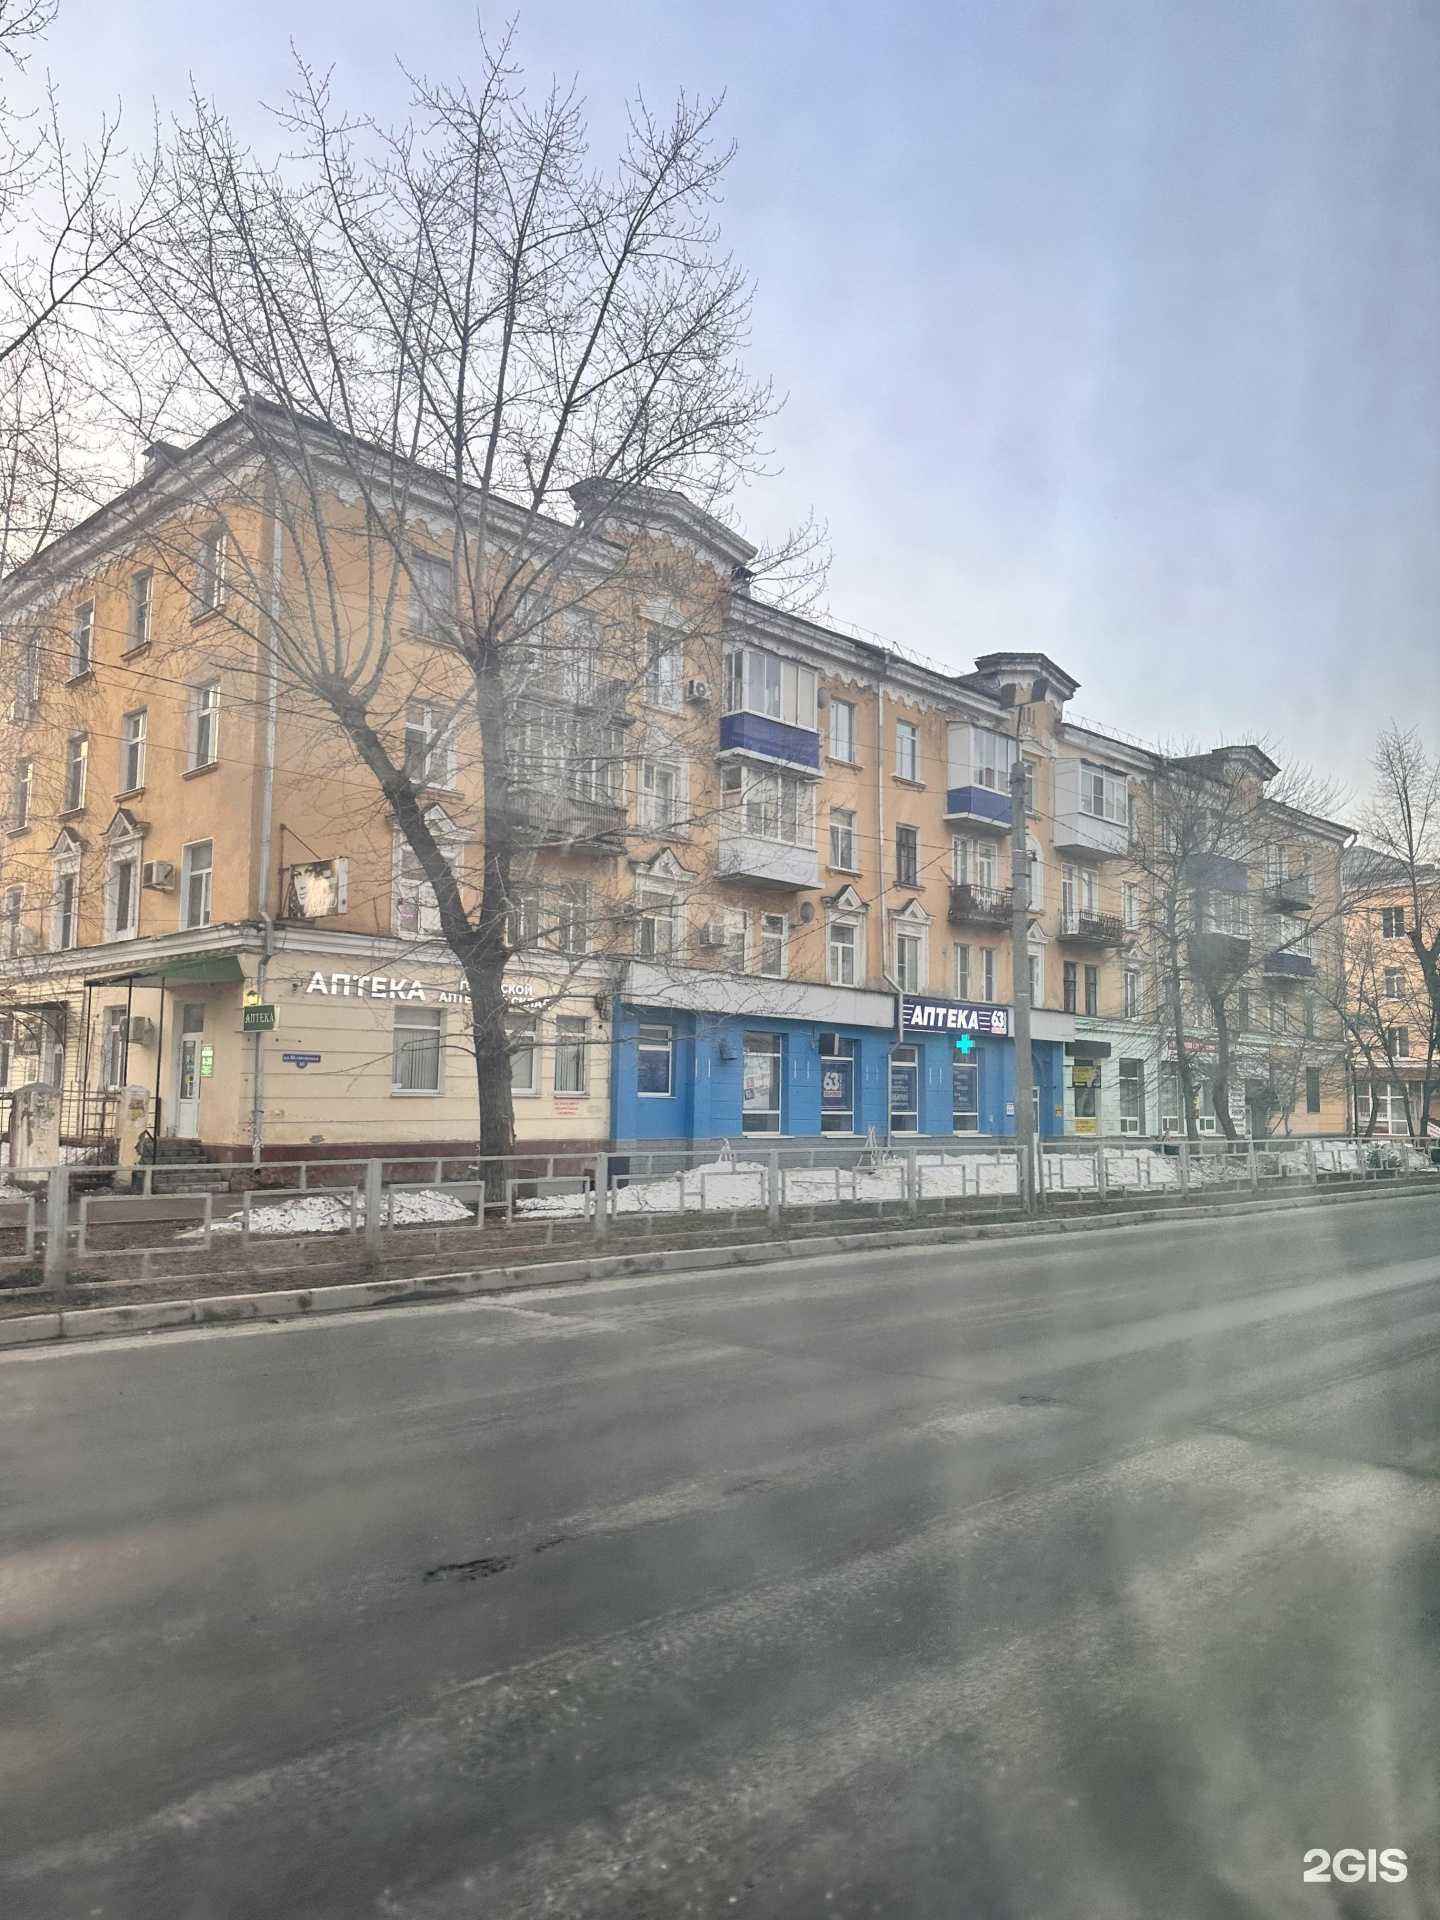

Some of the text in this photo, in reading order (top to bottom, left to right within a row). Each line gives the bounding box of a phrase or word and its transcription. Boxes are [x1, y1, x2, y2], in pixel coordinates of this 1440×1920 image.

[306, 971, 426, 1001] АПТЕКА
[245, 1012, 274, 1024] АПТЕКА
[911, 1005, 979, 1030] АПТЕКА
[823, 1071, 840, 1090] 63
